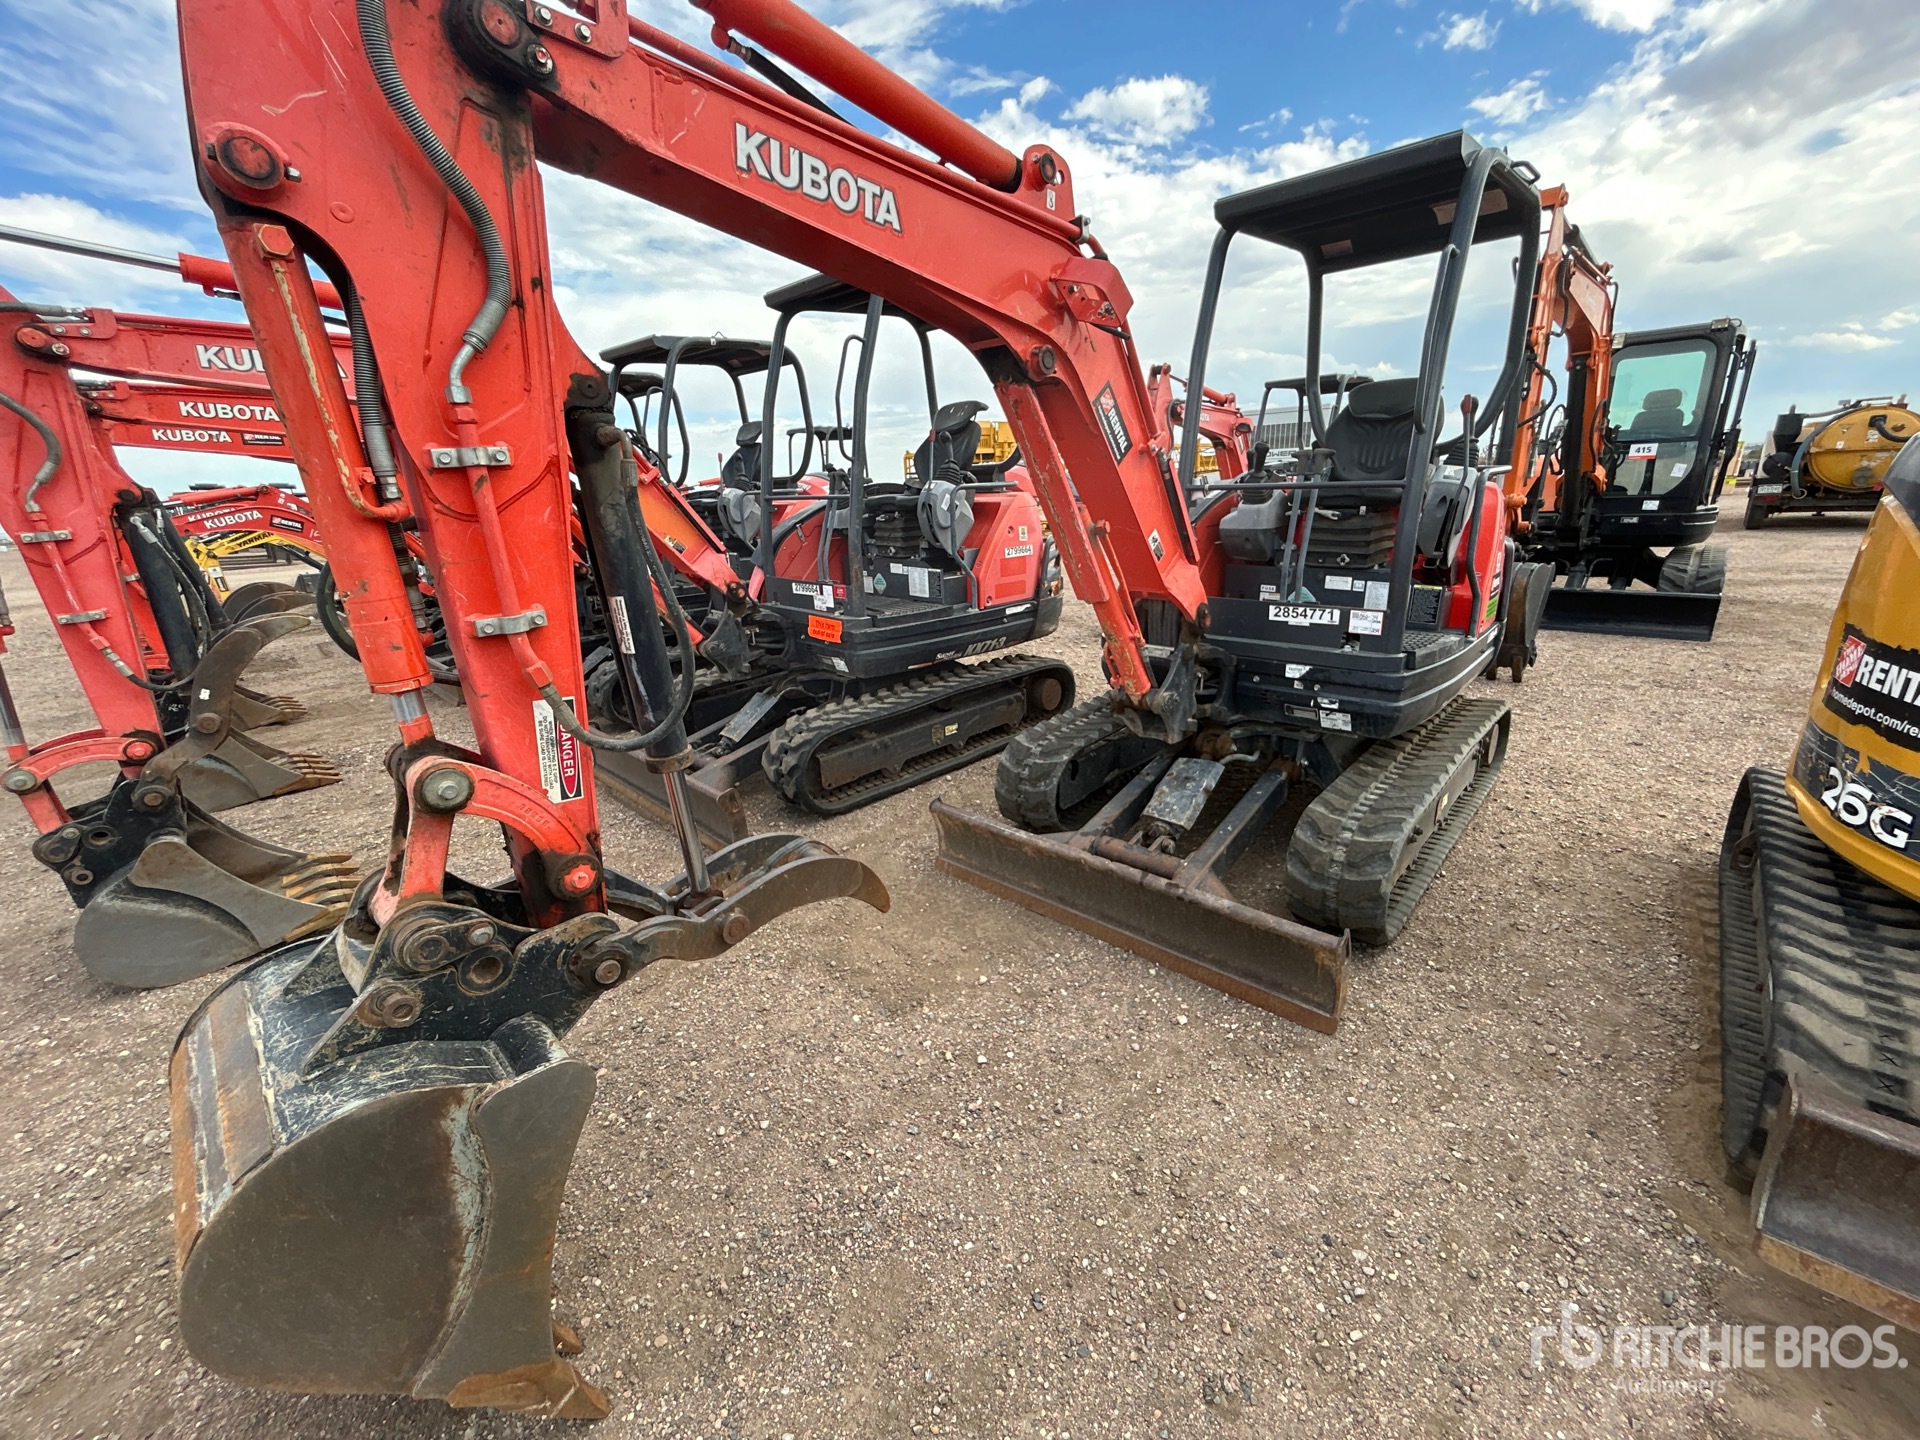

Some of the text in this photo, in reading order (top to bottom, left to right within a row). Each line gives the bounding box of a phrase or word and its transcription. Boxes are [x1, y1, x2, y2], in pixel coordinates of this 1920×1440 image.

[735, 122, 902, 232] KUBOTA
[178, 401, 282, 421] KUBOTA
[151, 429, 233, 444] KUBOTA
[1107, 407, 1128, 454] RENTAL
[1634, 446, 1653, 454] 415
[203, 510, 264, 529] KUBOTA
[1006, 546, 1032, 556] 2799664
[1273, 606, 1335, 621] 2854771
[1854, 653, 1920, 707] RENT
[542, 715, 548, 724] DO
[1831, 686, 1920, 739] homedepot.com/re
[544, 734, 552, 764] TRANSPORT
[1820, 765, 1915, 849] 26G
